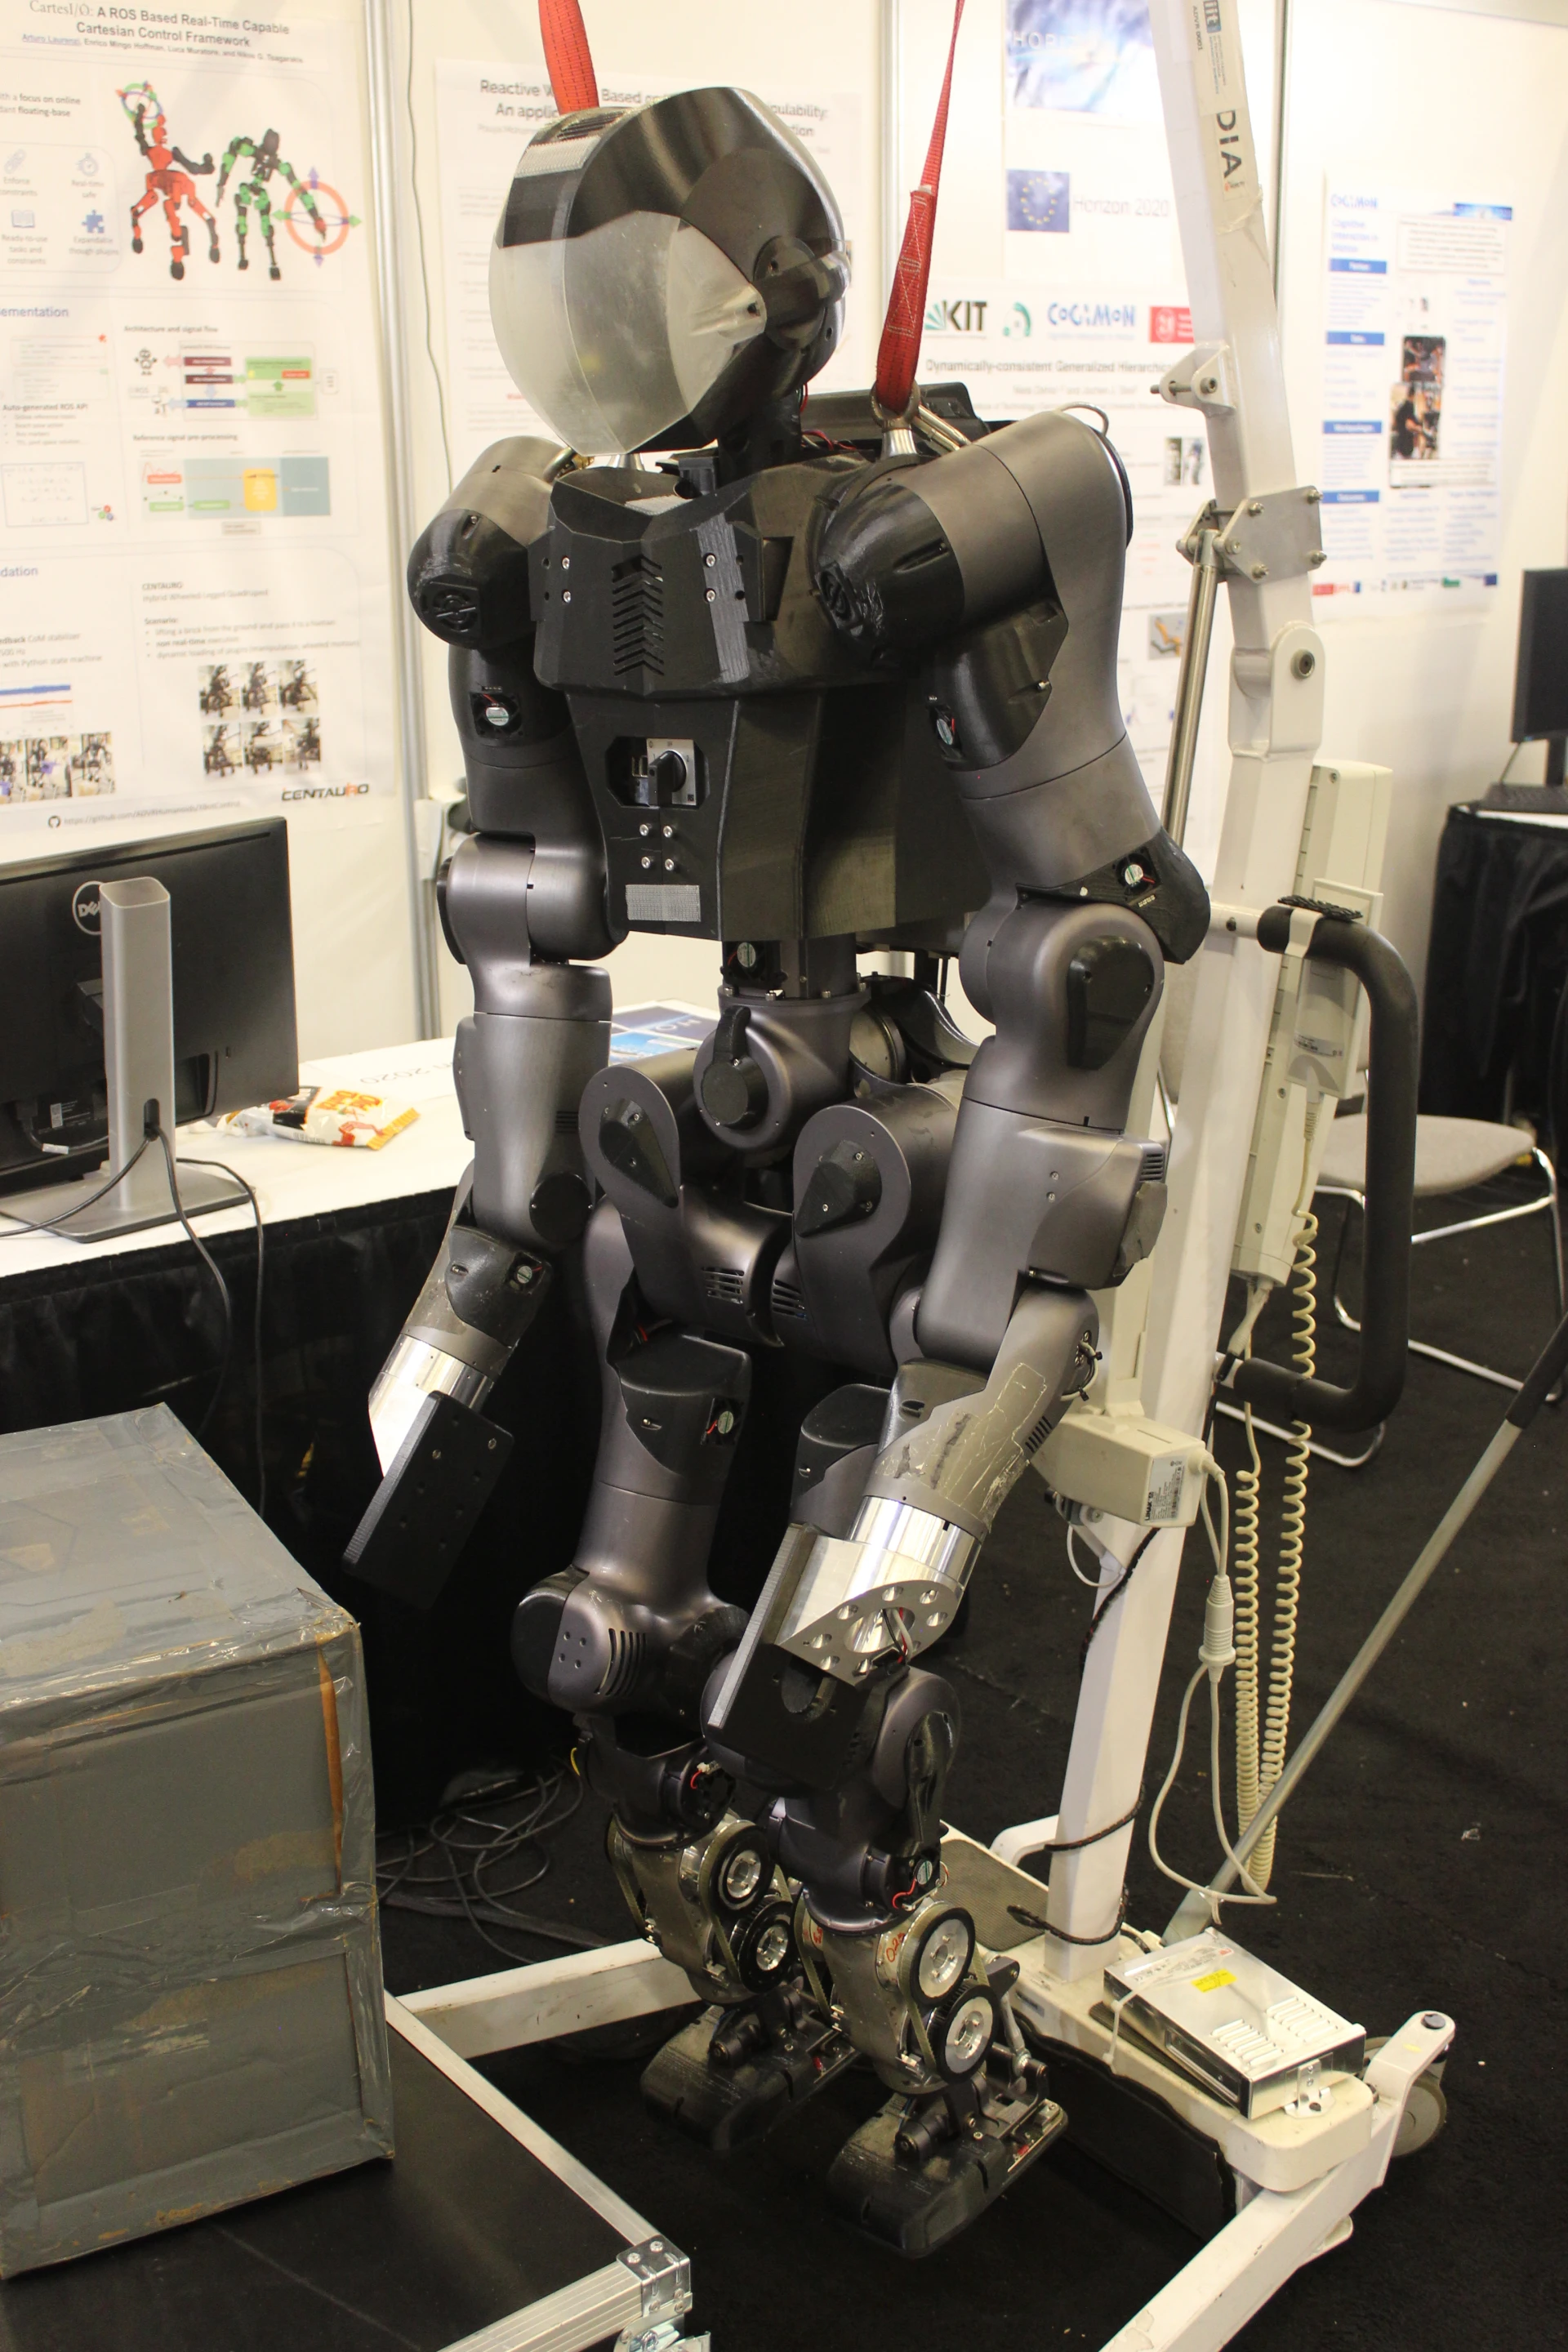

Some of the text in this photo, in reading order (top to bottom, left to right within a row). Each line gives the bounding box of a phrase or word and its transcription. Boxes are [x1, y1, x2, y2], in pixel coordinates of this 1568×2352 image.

[97, 7, 106, 18] A
[109, 7, 137, 20] ROS
[140, 10, 178, 24] Based
[181, 14, 239, 30] Real-Time
[243, 20, 290, 34] Capable
[77, 21, 251, 47] Cartesian Control Framework
[84, 38, 107, 47] Enrico
[109, 39, 131, 50] Mingo
[20, 93, 42, 103] focus
[56, 96, 82, 105] online
[480, 79, 541, 96] Reactive
[601, 87, 641, 104] Based
[18, 105, 72, 118] floating-base
[496, 102, 516, 117] An
[1072, 195, 1170, 217] Horizon 2020
[946, 301, 987, 332] KIT
[924, 359, 1052, 375] Dynamically-consistent
[1055, 359, 1115, 373] Generalized
[281, 782, 370, 803] CENTAURO
